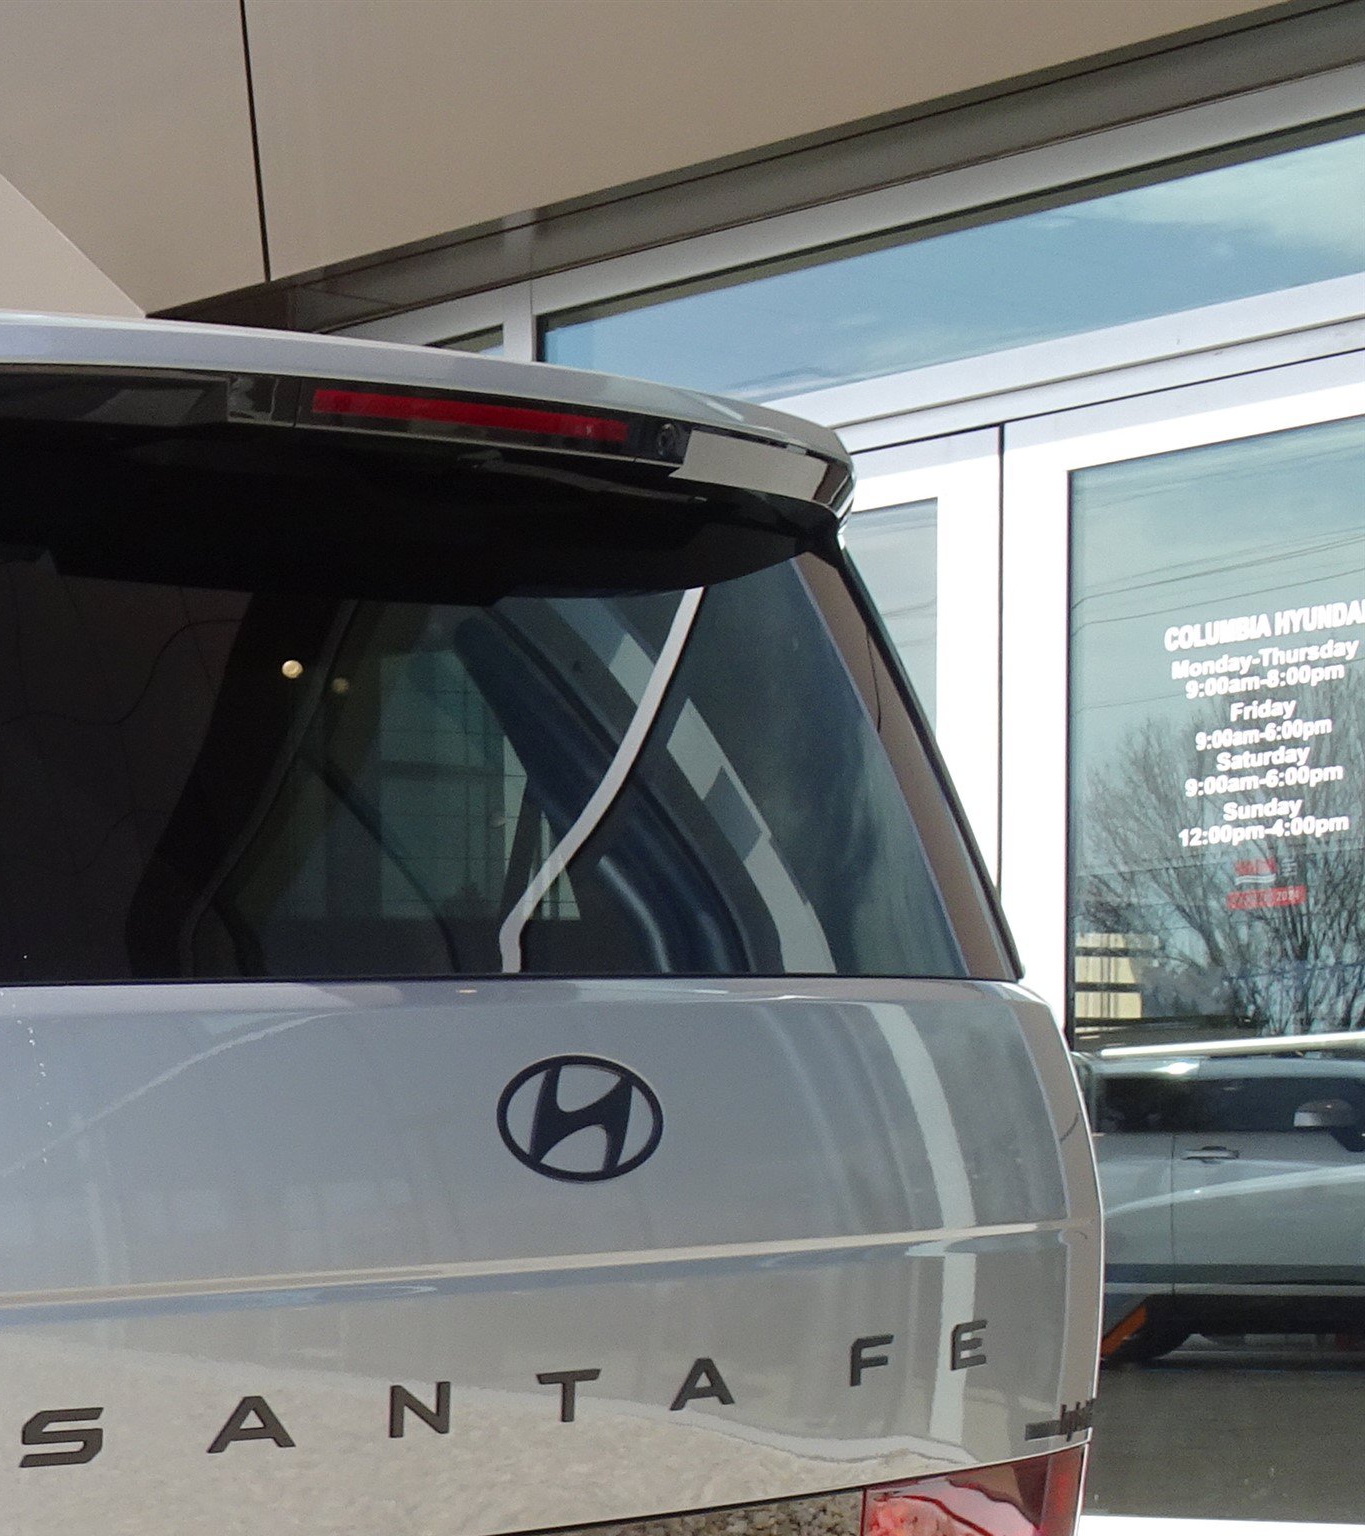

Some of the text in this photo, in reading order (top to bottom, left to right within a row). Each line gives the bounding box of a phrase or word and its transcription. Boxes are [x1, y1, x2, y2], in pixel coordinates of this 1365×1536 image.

[1164, 614, 1272, 652] COLUMBIA
[1171, 639, 1360, 679] Monday-Thursday
[1185, 664, 1345, 699] 9:00am-8:00pm
[1230, 699, 1296, 722] Friday
[1195, 718, 1333, 751] 9:00am-6:00pm
[1216, 745, 1310, 772] Saturday
[1184, 765, 1344, 797] 9:00am-6:00pm
[1223, 797, 1303, 822] Sunday
[1178, 815, 1349, 847] 12:00pm-4:00pm
[18, 1319, 989, 1468] SANTA FE
